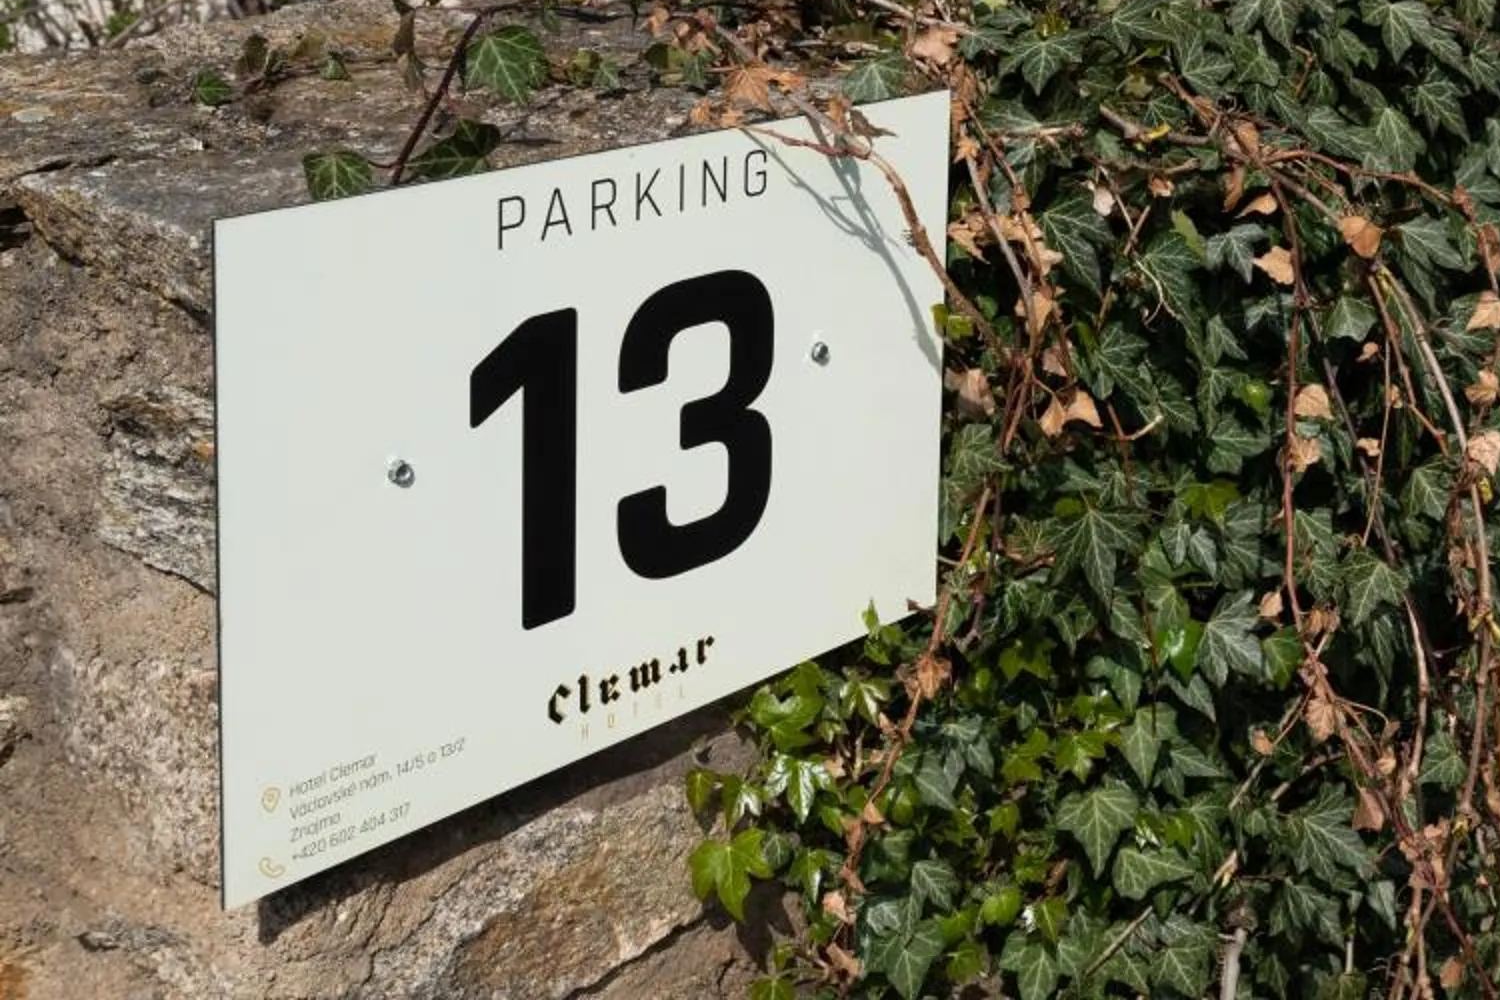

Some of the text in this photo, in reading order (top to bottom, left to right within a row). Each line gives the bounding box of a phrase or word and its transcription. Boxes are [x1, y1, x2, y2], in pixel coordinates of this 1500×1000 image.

[498, 149, 769, 251] PARKING
[469, 269, 775, 631] 13
[547, 635, 716, 725] Clemar
